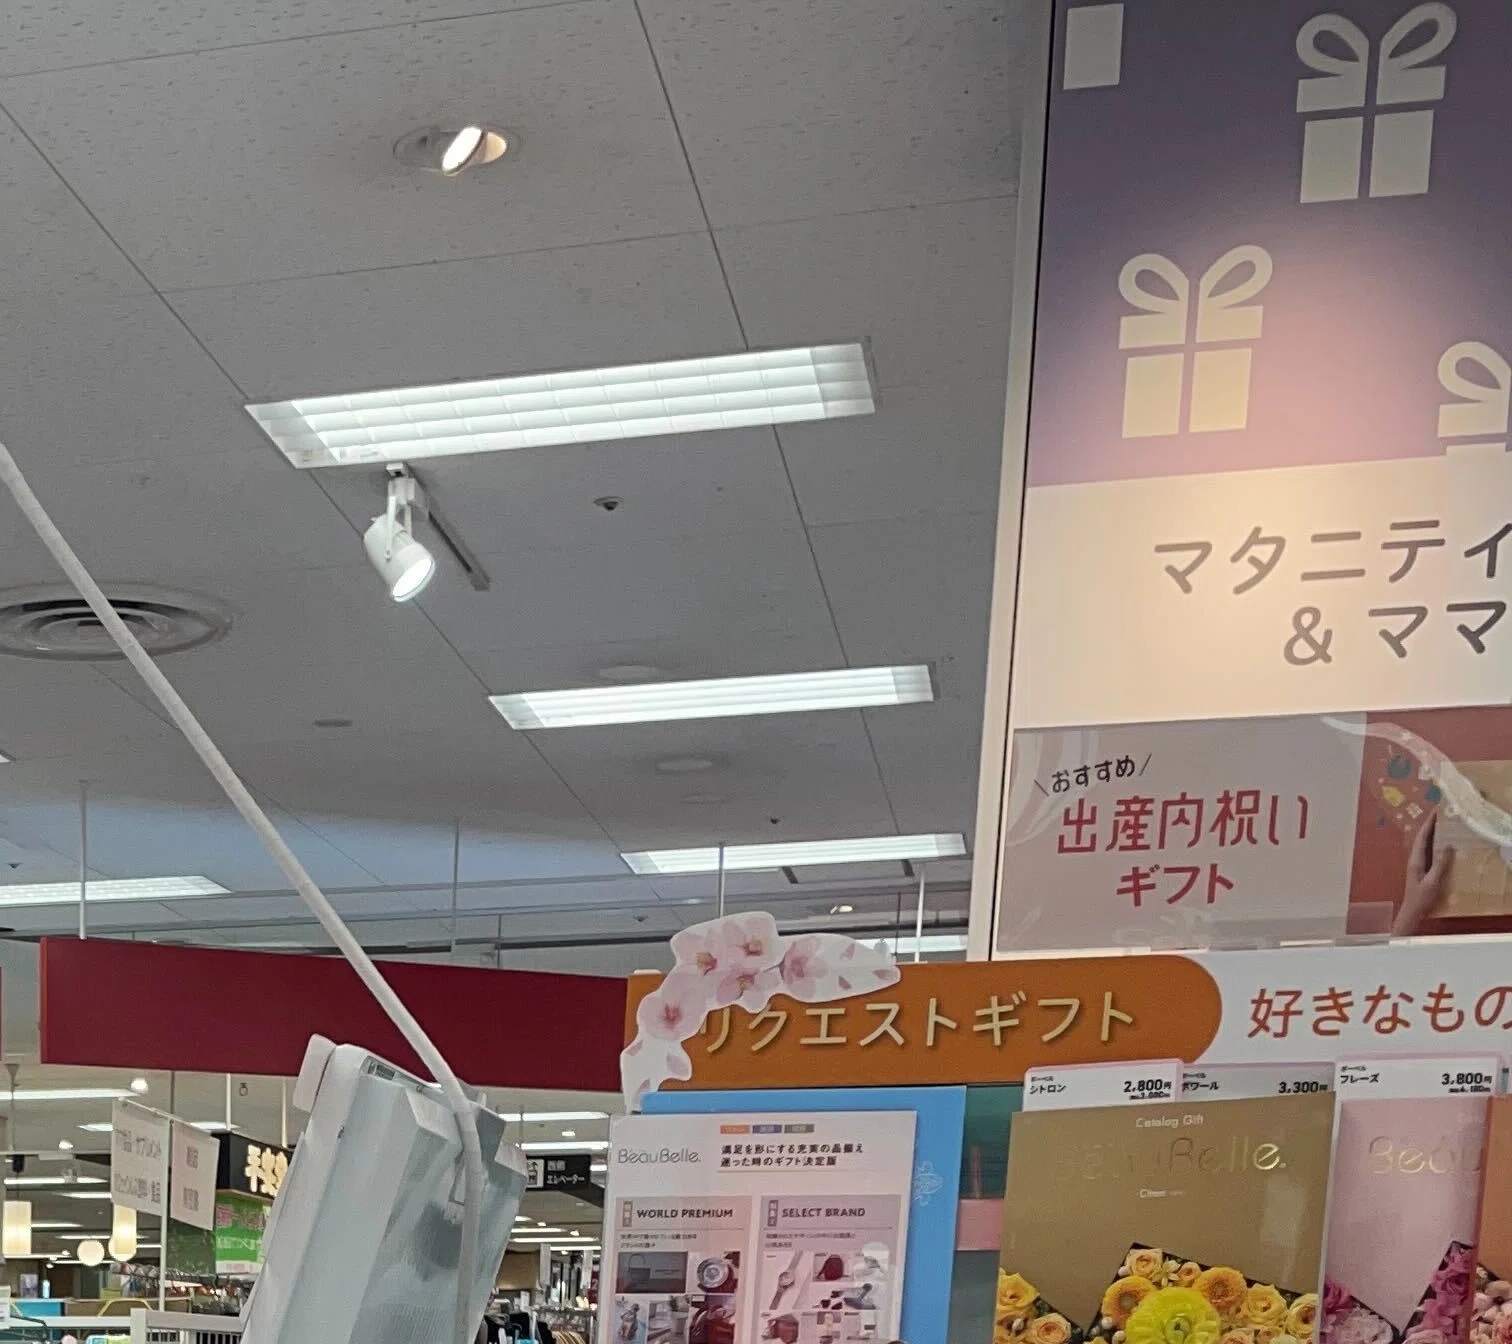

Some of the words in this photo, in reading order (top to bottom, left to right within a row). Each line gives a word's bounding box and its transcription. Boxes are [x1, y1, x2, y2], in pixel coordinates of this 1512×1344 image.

[1283, 605, 1333, 666] &
[1368, 600, 1507, 658] ママ
[1051, 755, 1136, 794] おすすめ
[1056, 788, 1310, 855] 出産内祝い
[1116, 863, 1235, 907] ギフト
[1247, 982, 1512, 1039] 好きなもの
[1340, 1073, 1380, 1084] フレーズ
[1441, 1073, 1492, 1085] 3,800円
[1029, 1083, 1067, 1094] シトロン
[1123, 1079, 1172, 1093] 2,800円
[637, 1208, 678, 1219] WORLD
[681, 1207, 734, 1219] PREMIUM
[782, 1207, 822, 1218] SELECT
[825, 1207, 865, 1218] BRAND
